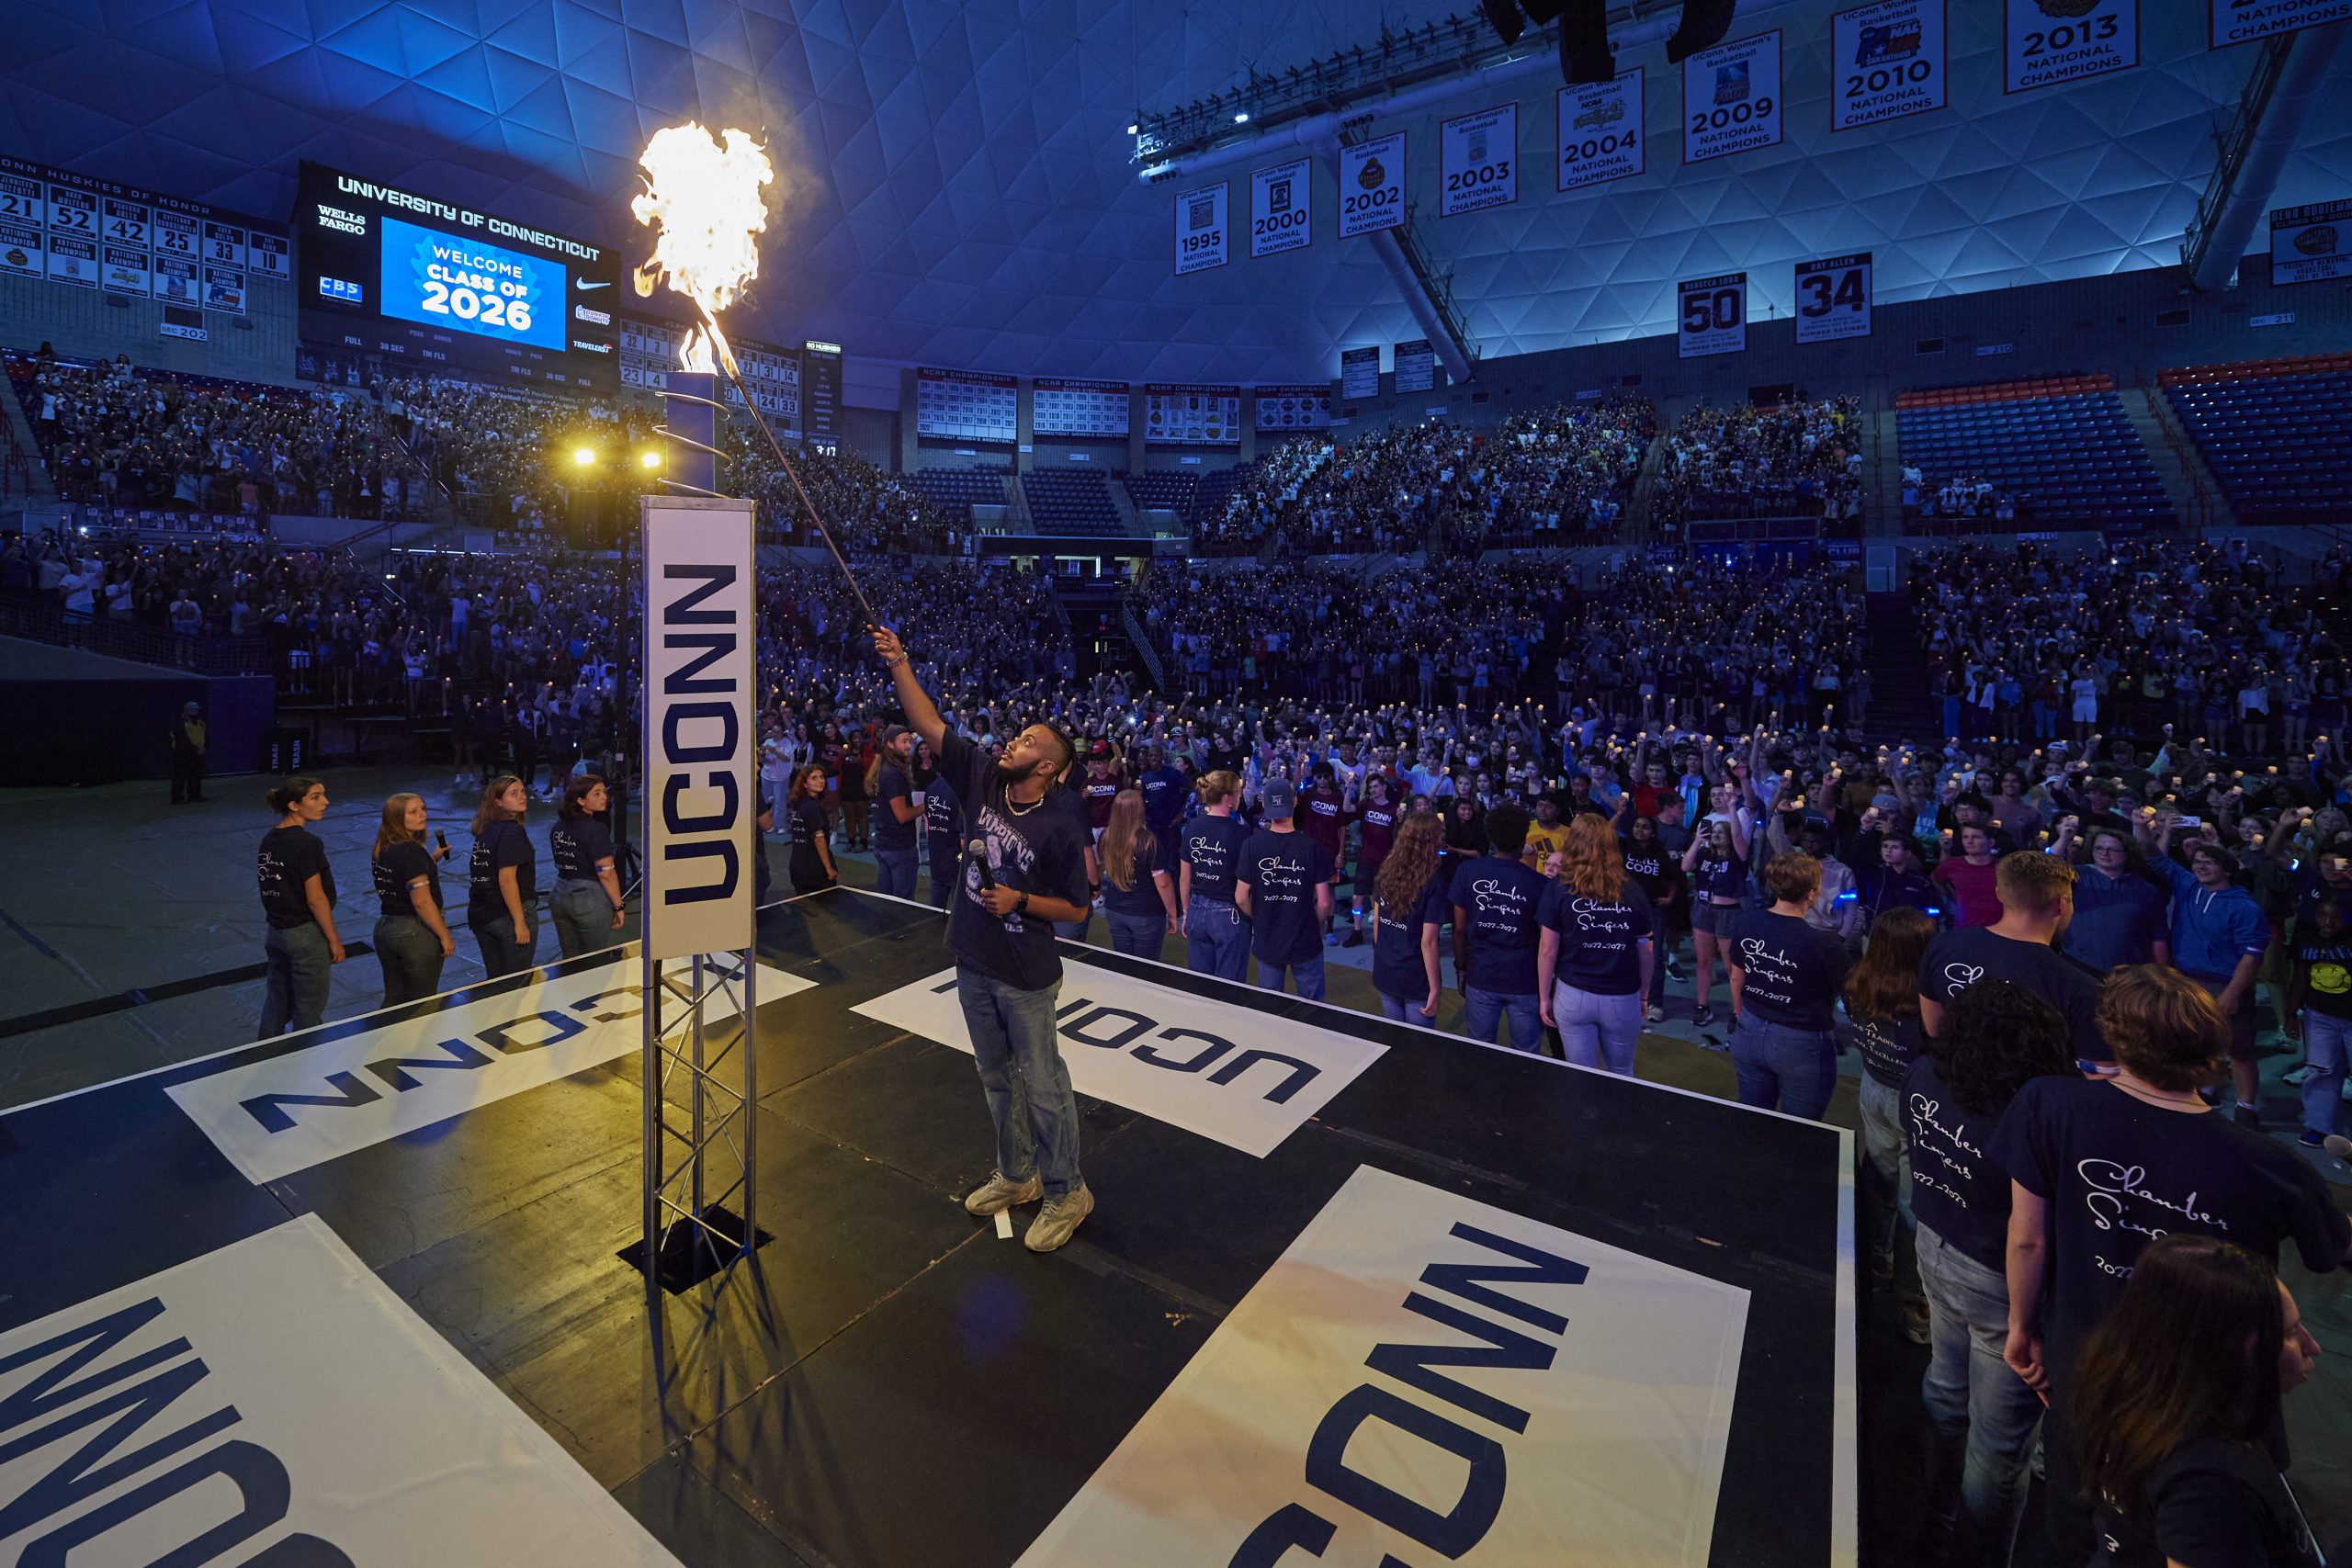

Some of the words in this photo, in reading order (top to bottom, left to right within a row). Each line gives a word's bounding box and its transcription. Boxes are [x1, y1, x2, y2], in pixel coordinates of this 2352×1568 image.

[1843, 6, 1880, 21] UConn
[1859, 6, 1917, 28] Basketball
[2228, 4, 2350, 39] CHAMPIONS
[2023, 14, 2119, 58] 2013
[1692, 49, 1724, 62] UConn
[1726, 35, 1771, 52] Women's
[1706, 48, 1757, 67] Basketball
[2027, 43, 2114, 71] NATIONAL
[1845, 60, 1931, 98] 2010
[2019, 55, 2122, 86] CHAMPIONS
[1566, 84, 1593, 96] UConn
[1578, 85, 1622, 102] Basketball
[1851, 86, 1926, 111] NATIONAL
[1448, 118, 1473, 129] UConn
[1475, 107, 1509, 120] Women's
[1690, 96, 1773, 135] 2009
[1845, 97, 1933, 125] CHAMPIONS
[1459, 118, 1498, 134] Basketball
[1700, 123, 1764, 145] NATIONAL
[1345, 144, 1367, 154] UConn
[1355, 146, 1389, 160] Basketball
[1564, 129, 1636, 164] 2004
[1694, 133, 1770, 158] CHAMPIONS
[1572, 154, 1630, 175] NATIONAL
[1447, 161, 1510, 192] 2003
[1567, 164, 1634, 186] CHAMPIONS
[47, 169, 122, 194] HUSKIES
[131, 190, 150, 199] OF
[159, 196, 210, 215] HONOR
[1344, 186, 1399, 214] 2002
[1453, 184, 1503, 201] NATIONAL
[1, 194, 33, 218] 21
[1449, 193, 1509, 212] CHAMPIONS
[57, 207, 89, 230] 52
[317, 204, 366, 225] WELLS
[337, 175, 457, 221] UNIVERSITY
[460, 209, 484, 228] OF
[488, 218, 600, 263] CONNECTICUT
[1255, 209, 1306, 235] 2000
[1350, 208, 1394, 223] NATIONAL
[2272, 207, 2299, 222] GENO
[110, 220, 143, 242] 42
[319, 215, 366, 235] FARGO
[1346, 217, 1397, 233] CHAMPIONS
[165, 231, 188, 251] 25
[1182, 231, 1221, 253] 1995
[1261, 230, 1300, 243] NATIONAL
[216, 242, 233, 260] 33
[1257, 238, 1304, 254] CHAMPIONS
[263, 252, 277, 270] 10
[433, 244, 523, 279] WELCOME
[1181, 257, 1223, 271] CHAMPIONS
[1183, 249, 1219, 262] NATIONAL
[321, 276, 358, 294] CBS
[426, 264, 495, 292] CLASS
[500, 281, 528, 299] OF
[1684, 278, 1717, 290] REBECCA
[1802, 269, 1865, 318] 34
[422, 280, 532, 331] 2026
[1683, 288, 1740, 333] 50
[2276, 314, 2294, 323] 211
[181, 328, 207, 340] 202
[345, 335, 363, 346] FULL
[627, 334, 638, 349] 32
[390, 343, 405, 354] SEC
[654, 341, 661, 353] 3
[1993, 344, 2011, 354] 210
[623, 367, 639, 383] 23
[743, 361, 753, 374] 23
[764, 365, 774, 378] 31
[785, 370, 793, 383] 14
[652, 374, 661, 387] 4
[950, 371, 1012, 383] CHAMPIONSHIP
[1064, 380, 1125, 389] CHAMPIONSHIP
[1175, 385, 1236, 393] CHAMPIONSHIP
[761, 396, 775, 409] 24
[781, 399, 796, 412] 33
[920, 433, 956, 441] CONNECTICUT
[662, 563, 739, 907] UCONN
[1145, 781, 1167, 790] UCONN
[1311, 799, 1339, 813] UCONN
[1189, 836, 1227, 854] Chamber
[1190, 849, 1223, 867] Singers
[1258, 856, 1306, 872] Chamber
[1625, 862, 1660, 876] CODE
[1261, 871, 1302, 887] Singers
[1263, 895, 1298, 903] 2022-2023
[1472, 879, 1528, 903] Chamber
[1476, 894, 1521, 916] Singers
[1571, 897, 1633, 914] Chamber
[1477, 920, 1518, 934] 2022-2023
[1577, 913, 1630, 933] Singers
[1581, 942, 1627, 952] 2022-2023
[1740, 937, 1799, 969] Chamber
[1744, 954, 1793, 985] Singers
[1744, 985, 1792, 1004] 2022-2023
[1866, 1021, 1878, 1032] A
[1864, 1027, 1907, 1052] TRADITION
[1910, 1092, 1983, 1158] Chamber
[1912, 1118, 1973, 1180] Singers
[2077, 1158, 2230, 1231] Chamber
[2086, 1191, 2168, 1242] Sing
[0, 1296, 356, 1568] ONN
